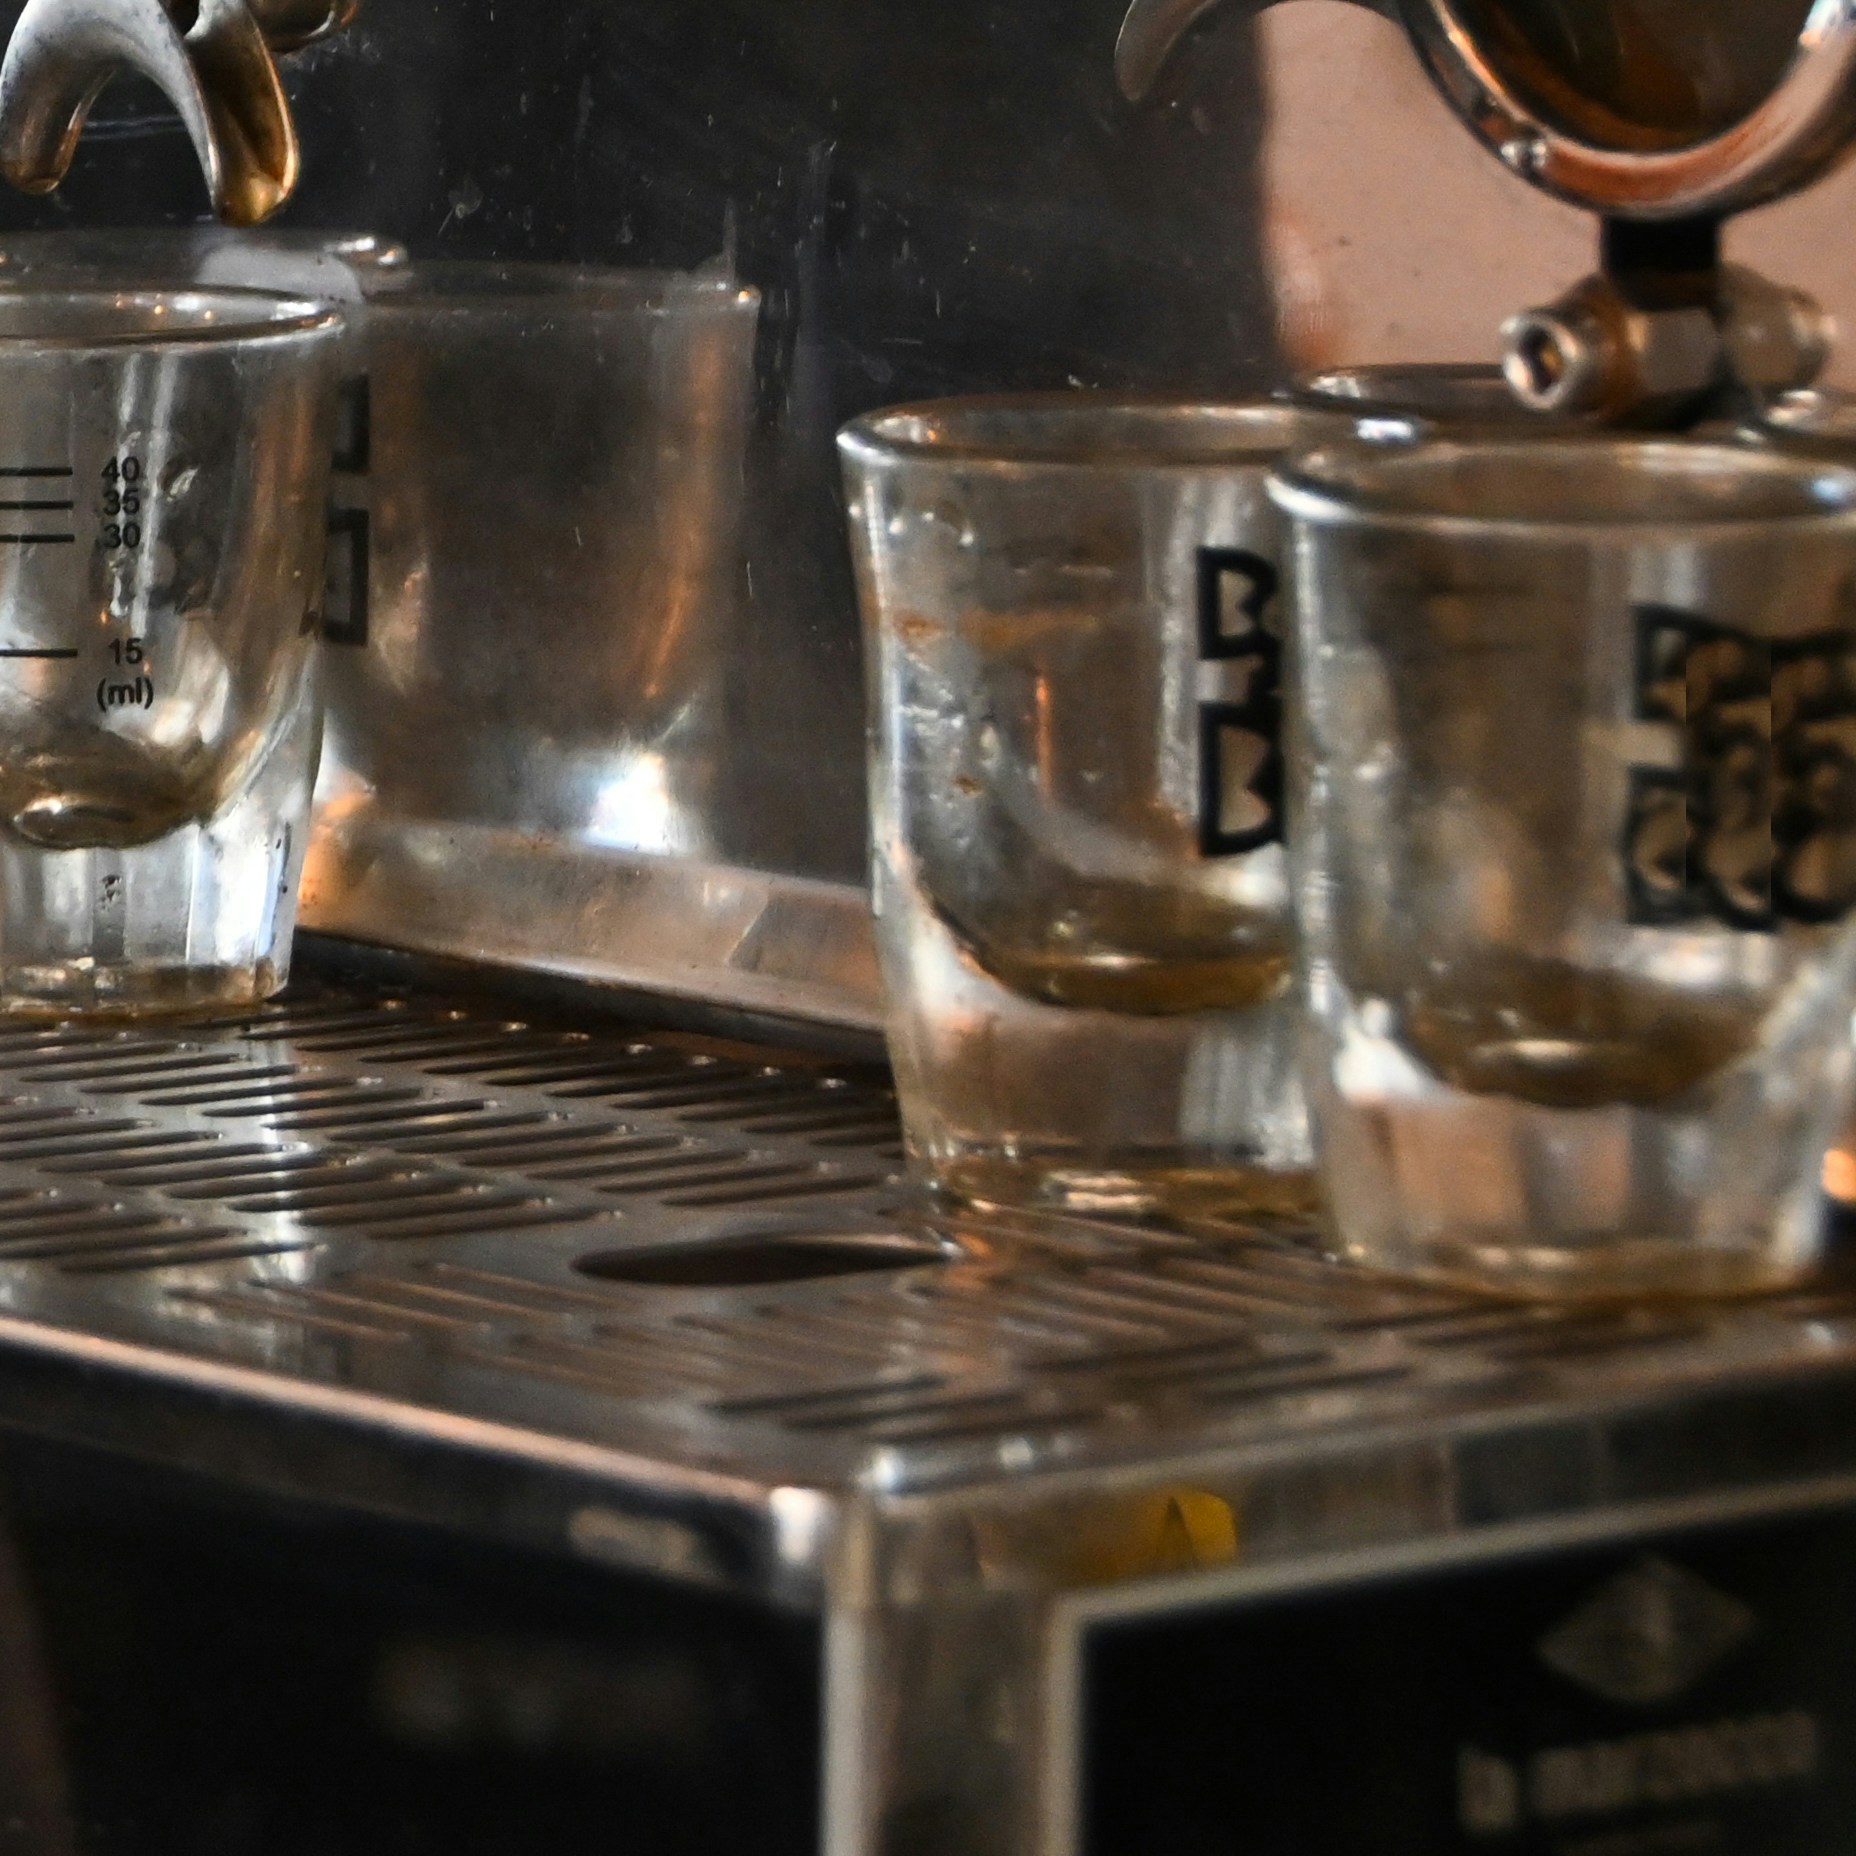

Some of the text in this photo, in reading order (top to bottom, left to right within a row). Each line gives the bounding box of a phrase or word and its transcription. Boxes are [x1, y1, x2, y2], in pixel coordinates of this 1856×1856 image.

[101, 456, 140, 483] 40
[103, 488, 139, 516] 35
[103, 522, 141, 549] 30
[108, 637, 144, 665] 15
[96, 676, 154, 713] (ml)
